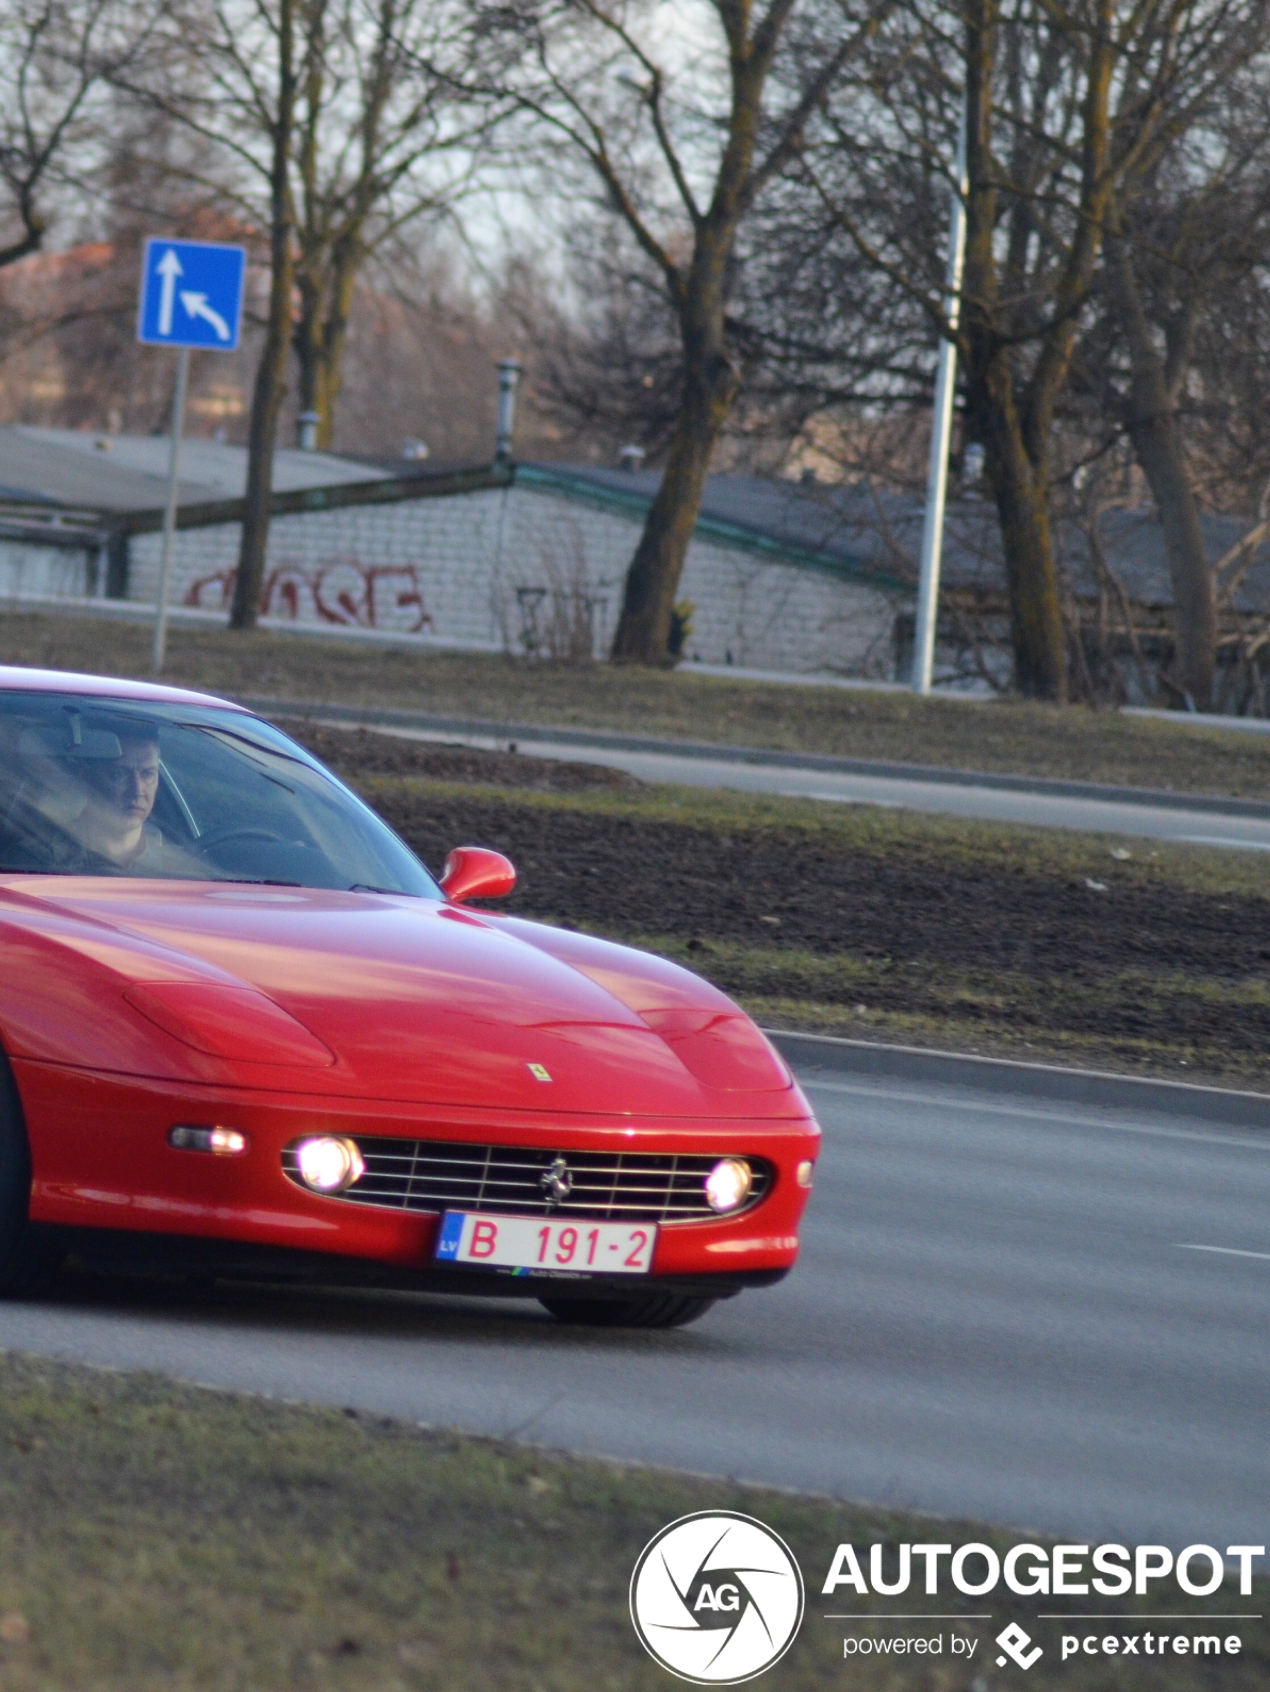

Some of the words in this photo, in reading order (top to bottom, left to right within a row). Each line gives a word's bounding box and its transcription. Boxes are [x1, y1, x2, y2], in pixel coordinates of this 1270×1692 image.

[440, 1240, 458, 1253] LV
[468, 1220, 498, 1258] B
[537, 1226, 648, 1267] 191-2
